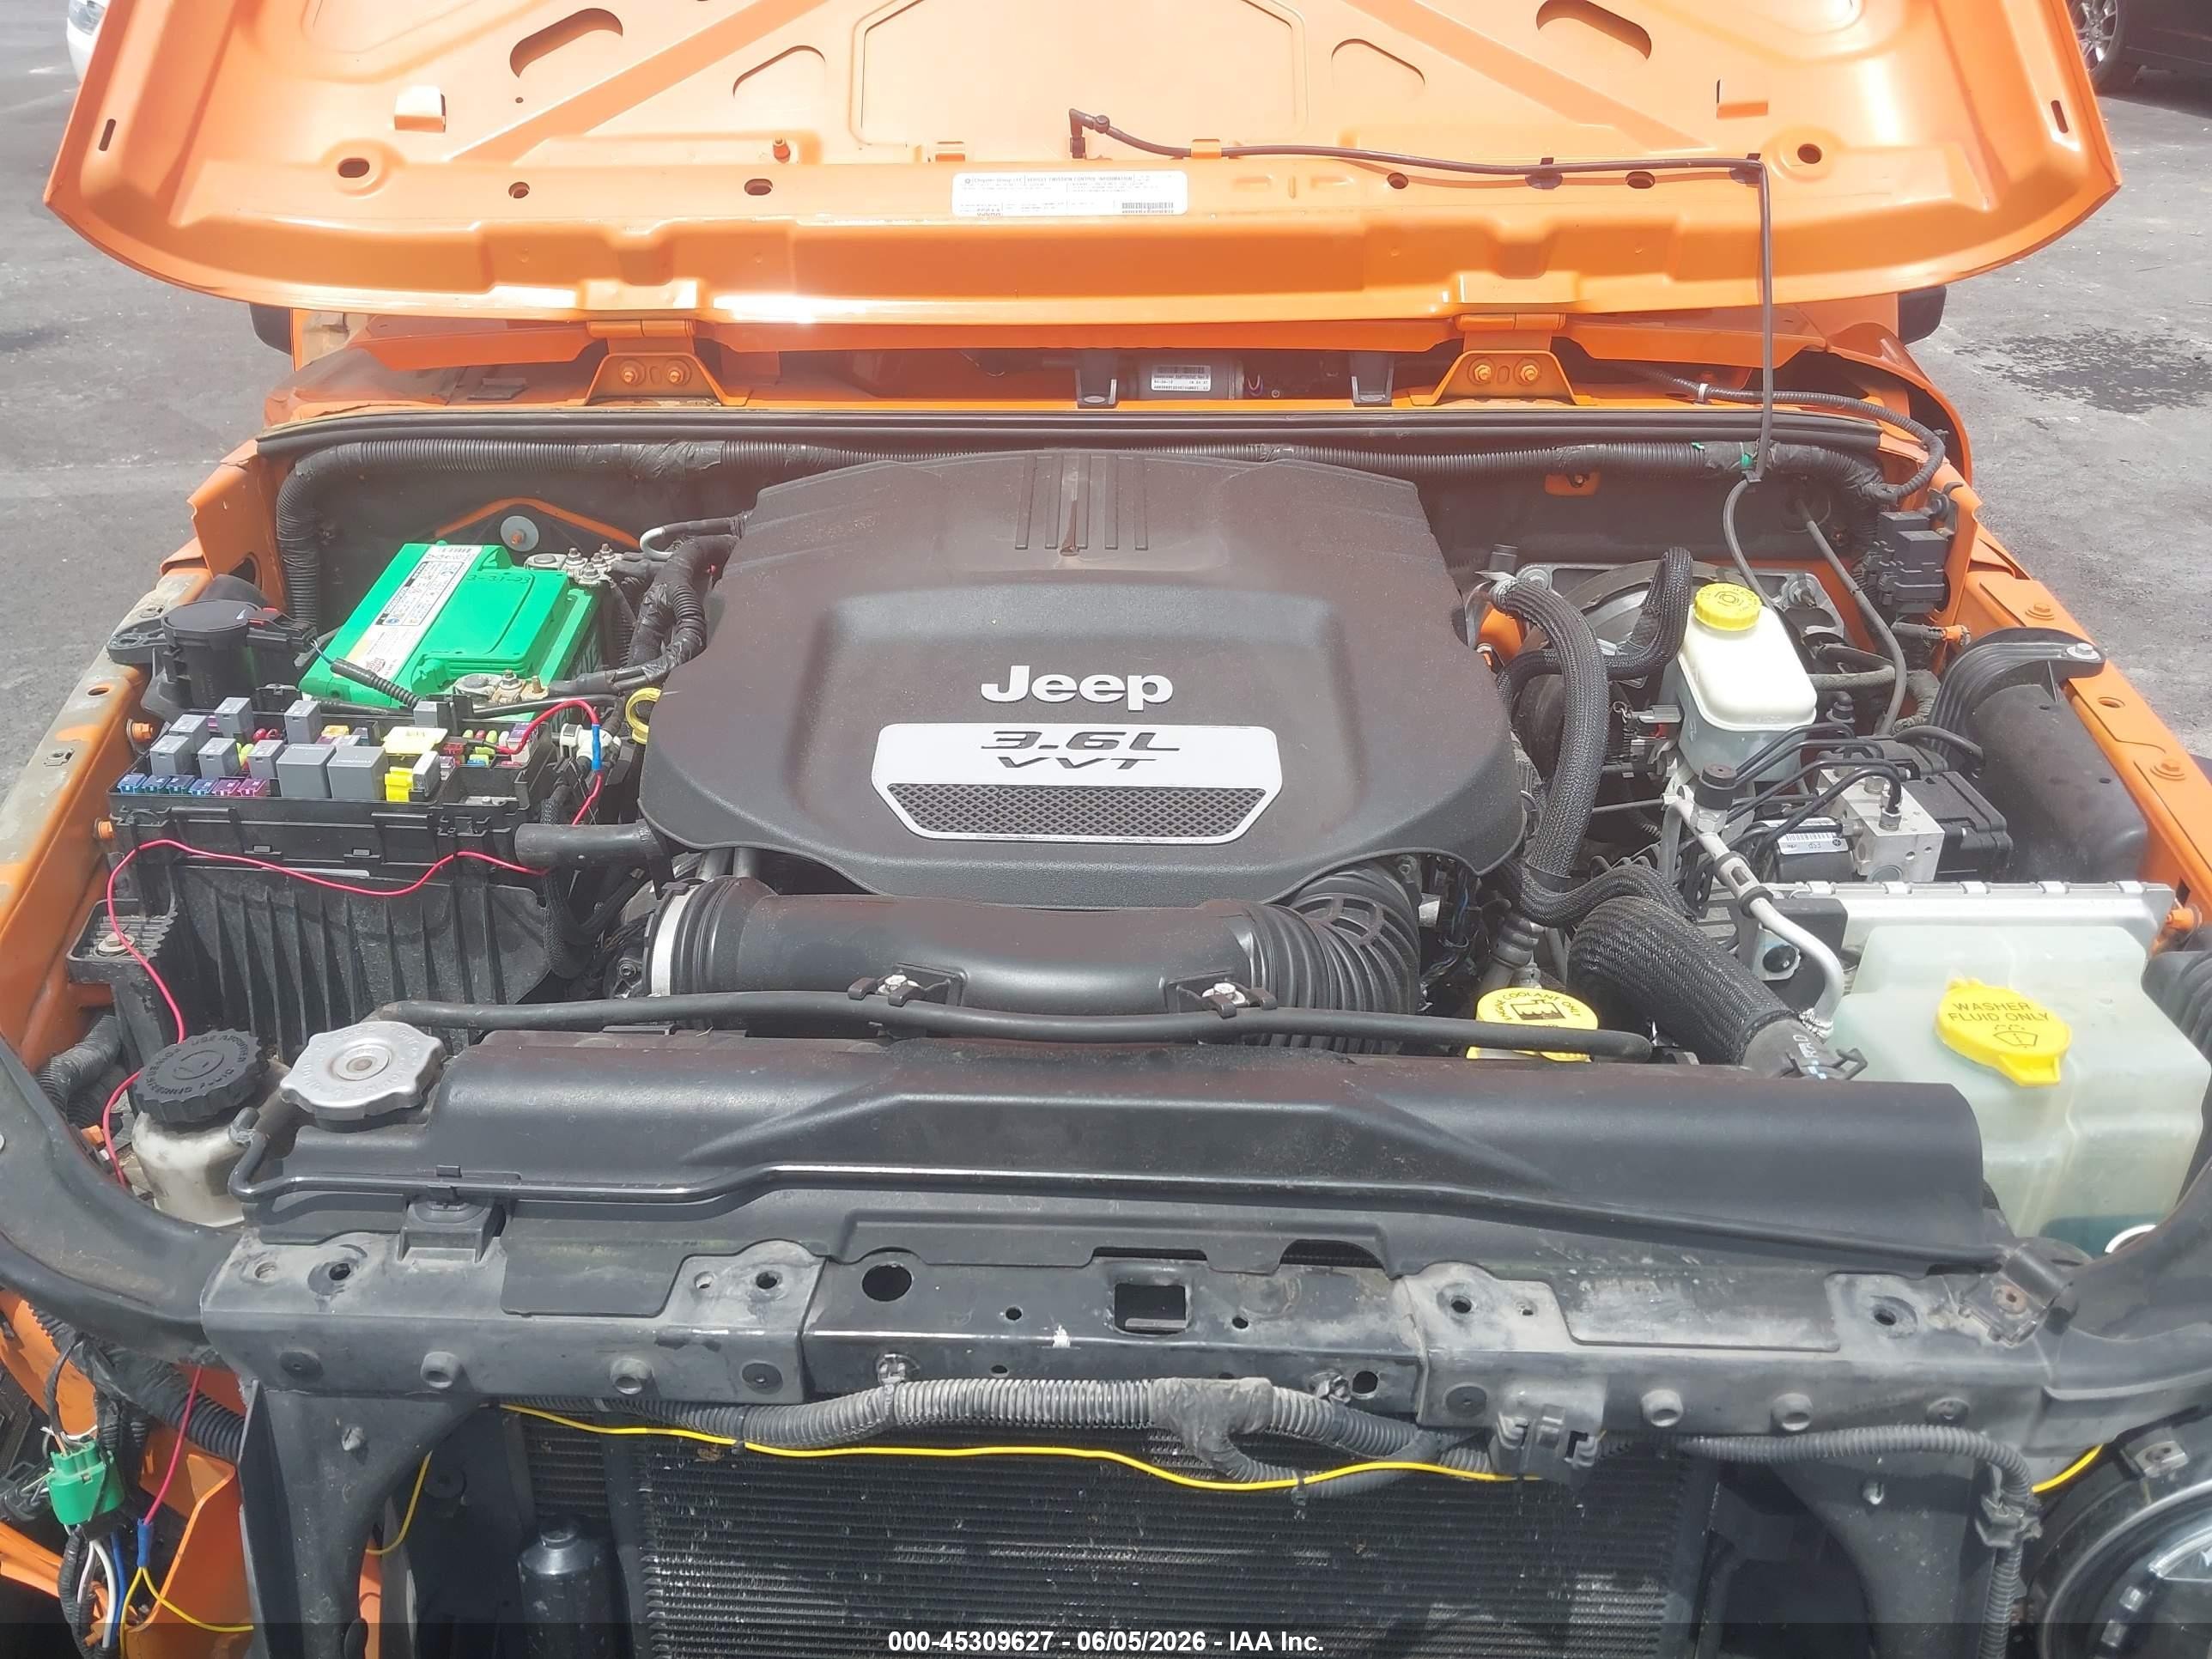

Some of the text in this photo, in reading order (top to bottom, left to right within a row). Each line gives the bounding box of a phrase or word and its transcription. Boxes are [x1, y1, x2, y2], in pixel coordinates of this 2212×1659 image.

[981, 665, 1174, 711] Jeep
[981, 731, 1181, 751] 3.6L
[997, 756, 1157, 769] VVT
[1502, 991, 1560, 1002] COOLANT
[1952, 1001, 2032, 1012] WASHER
[1948, 1012, 2050, 1022] FLUID ONLY
